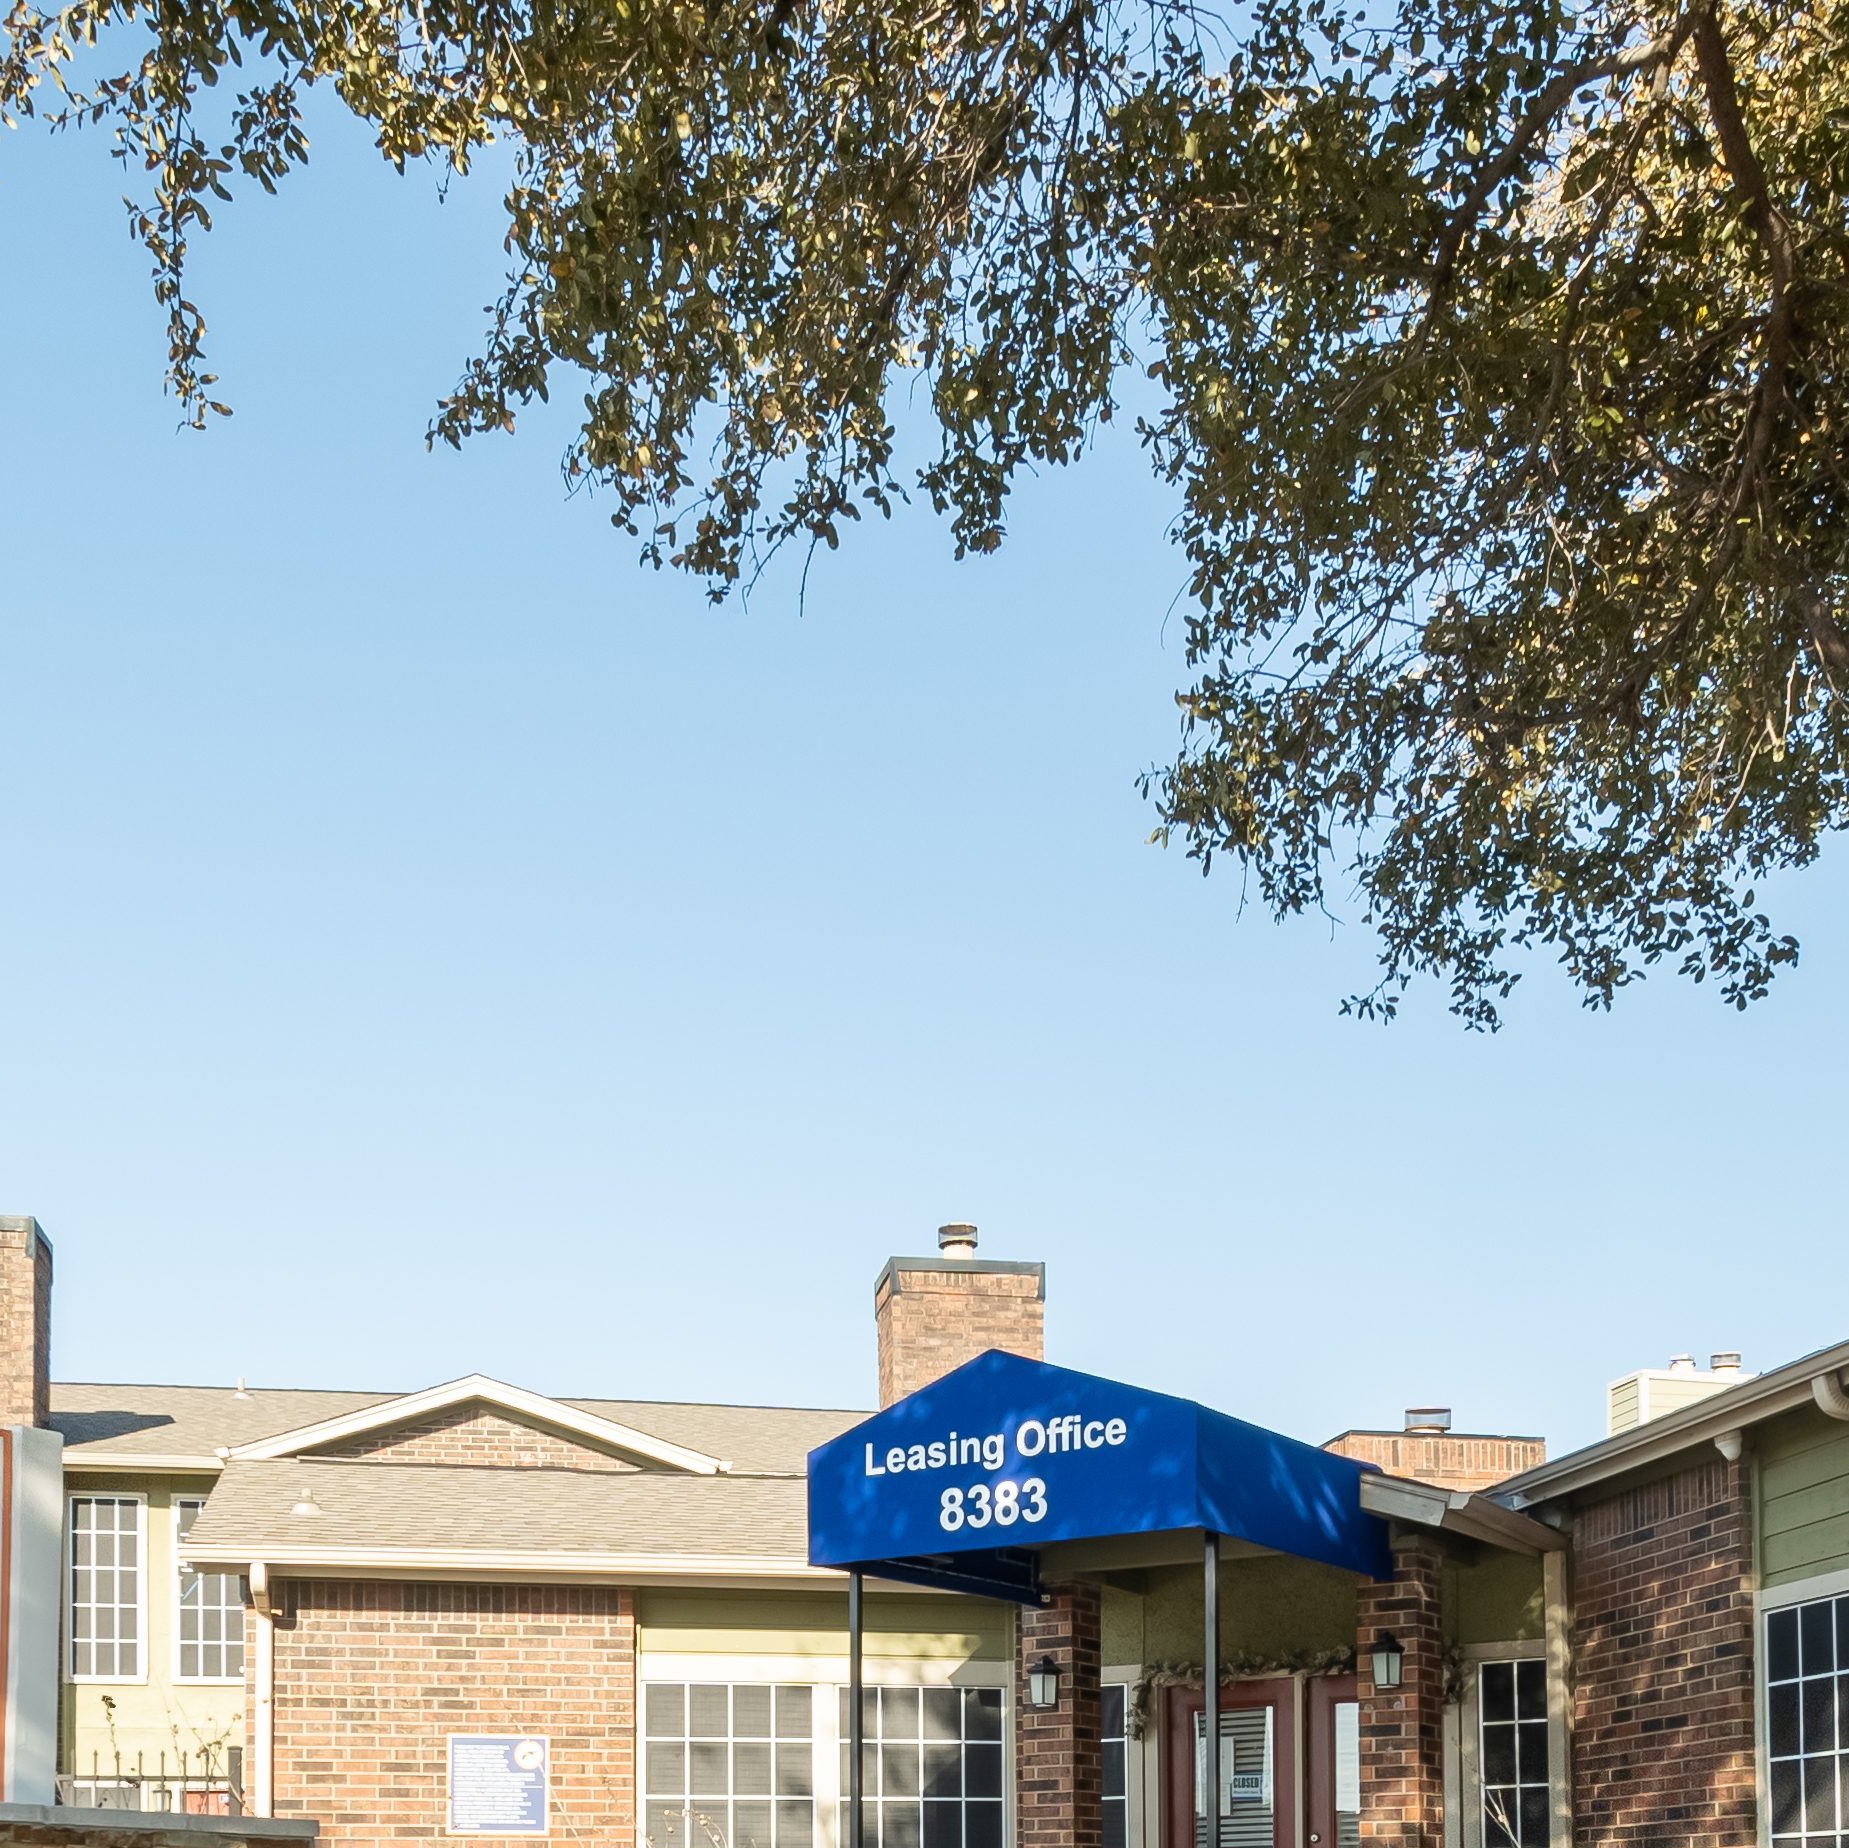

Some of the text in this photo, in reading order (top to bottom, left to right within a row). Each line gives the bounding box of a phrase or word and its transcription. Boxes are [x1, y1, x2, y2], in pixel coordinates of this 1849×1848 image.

[865, 1413, 1127, 1477] Leasing Office
[939, 1477, 1048, 1532] 8383
[1233, 1777, 1258, 1788] CLOSED
